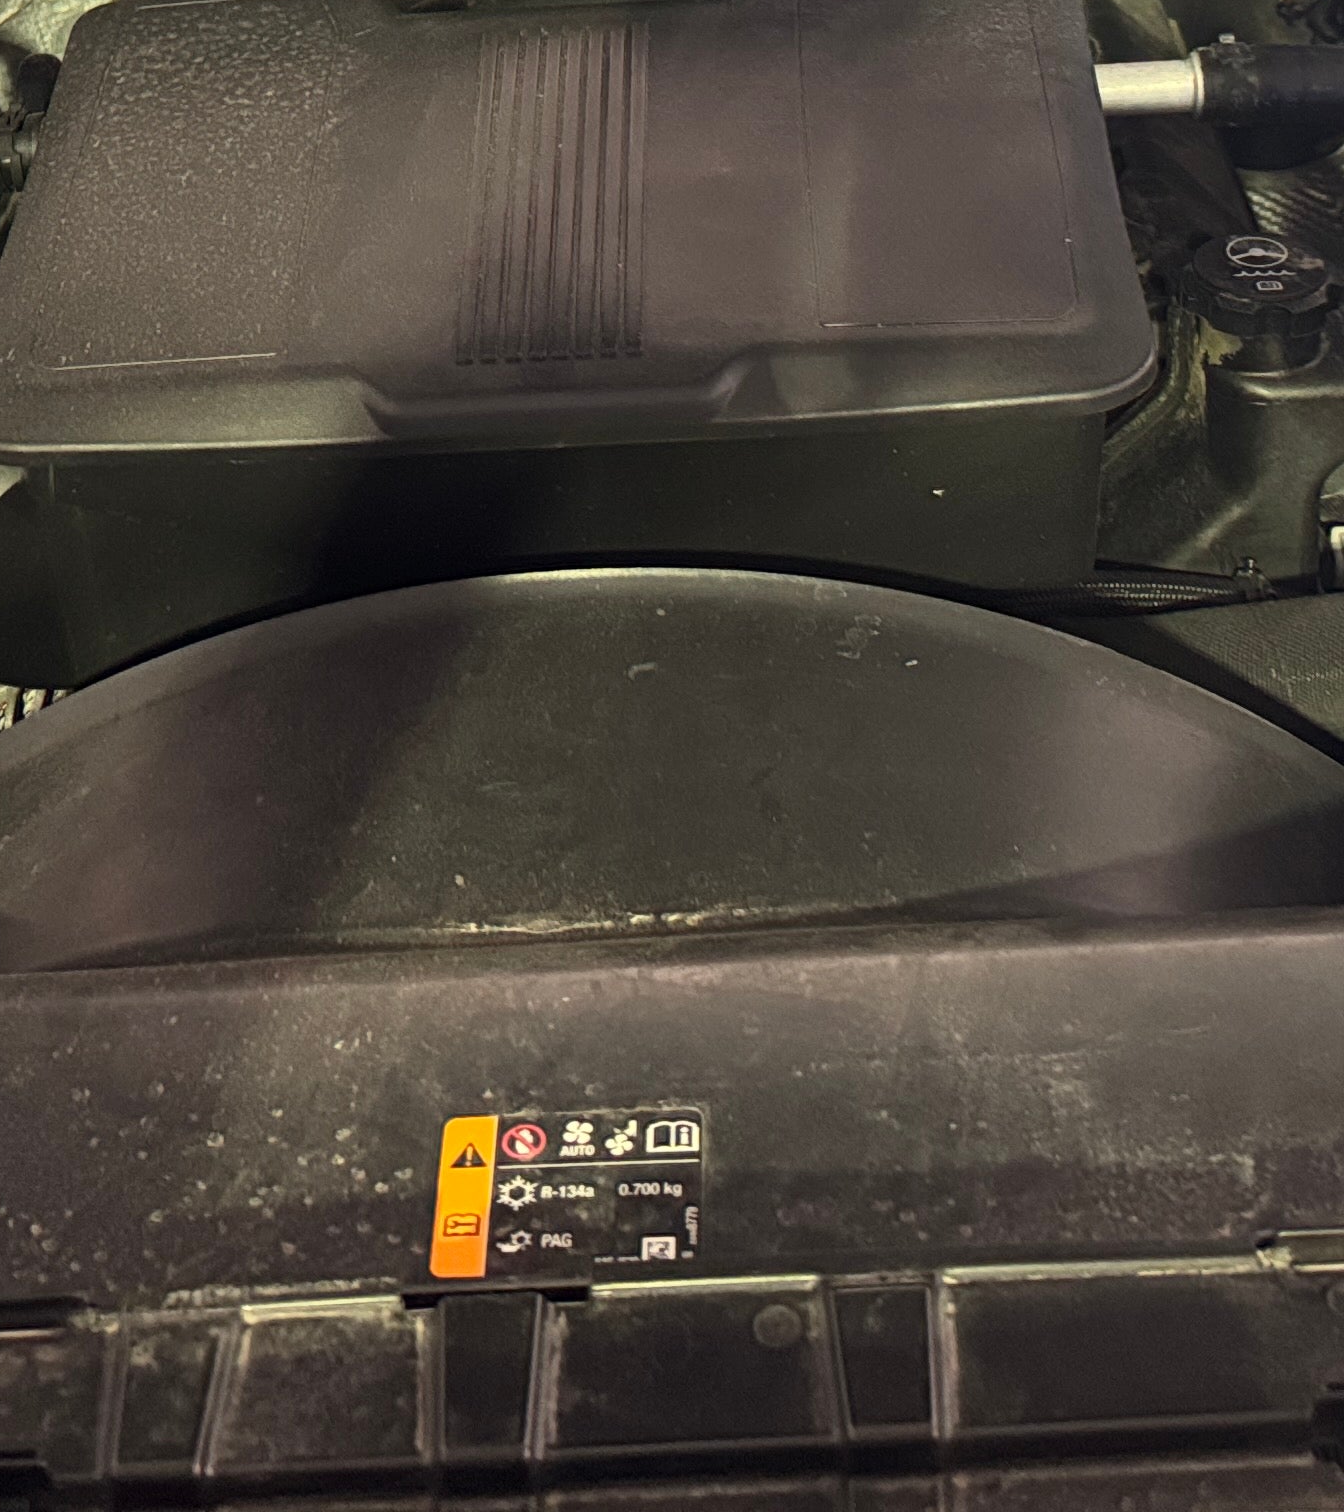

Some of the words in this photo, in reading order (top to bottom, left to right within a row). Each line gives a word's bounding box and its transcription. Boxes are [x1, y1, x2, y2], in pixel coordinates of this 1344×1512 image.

[559, 1144, 596, 1157] AUTO
[540, 1183, 595, 1199] R-134a
[618, 1182, 660, 1197] 0.700
[663, 1181, 683, 1197] kg
[540, 1232, 574, 1248] PAG
